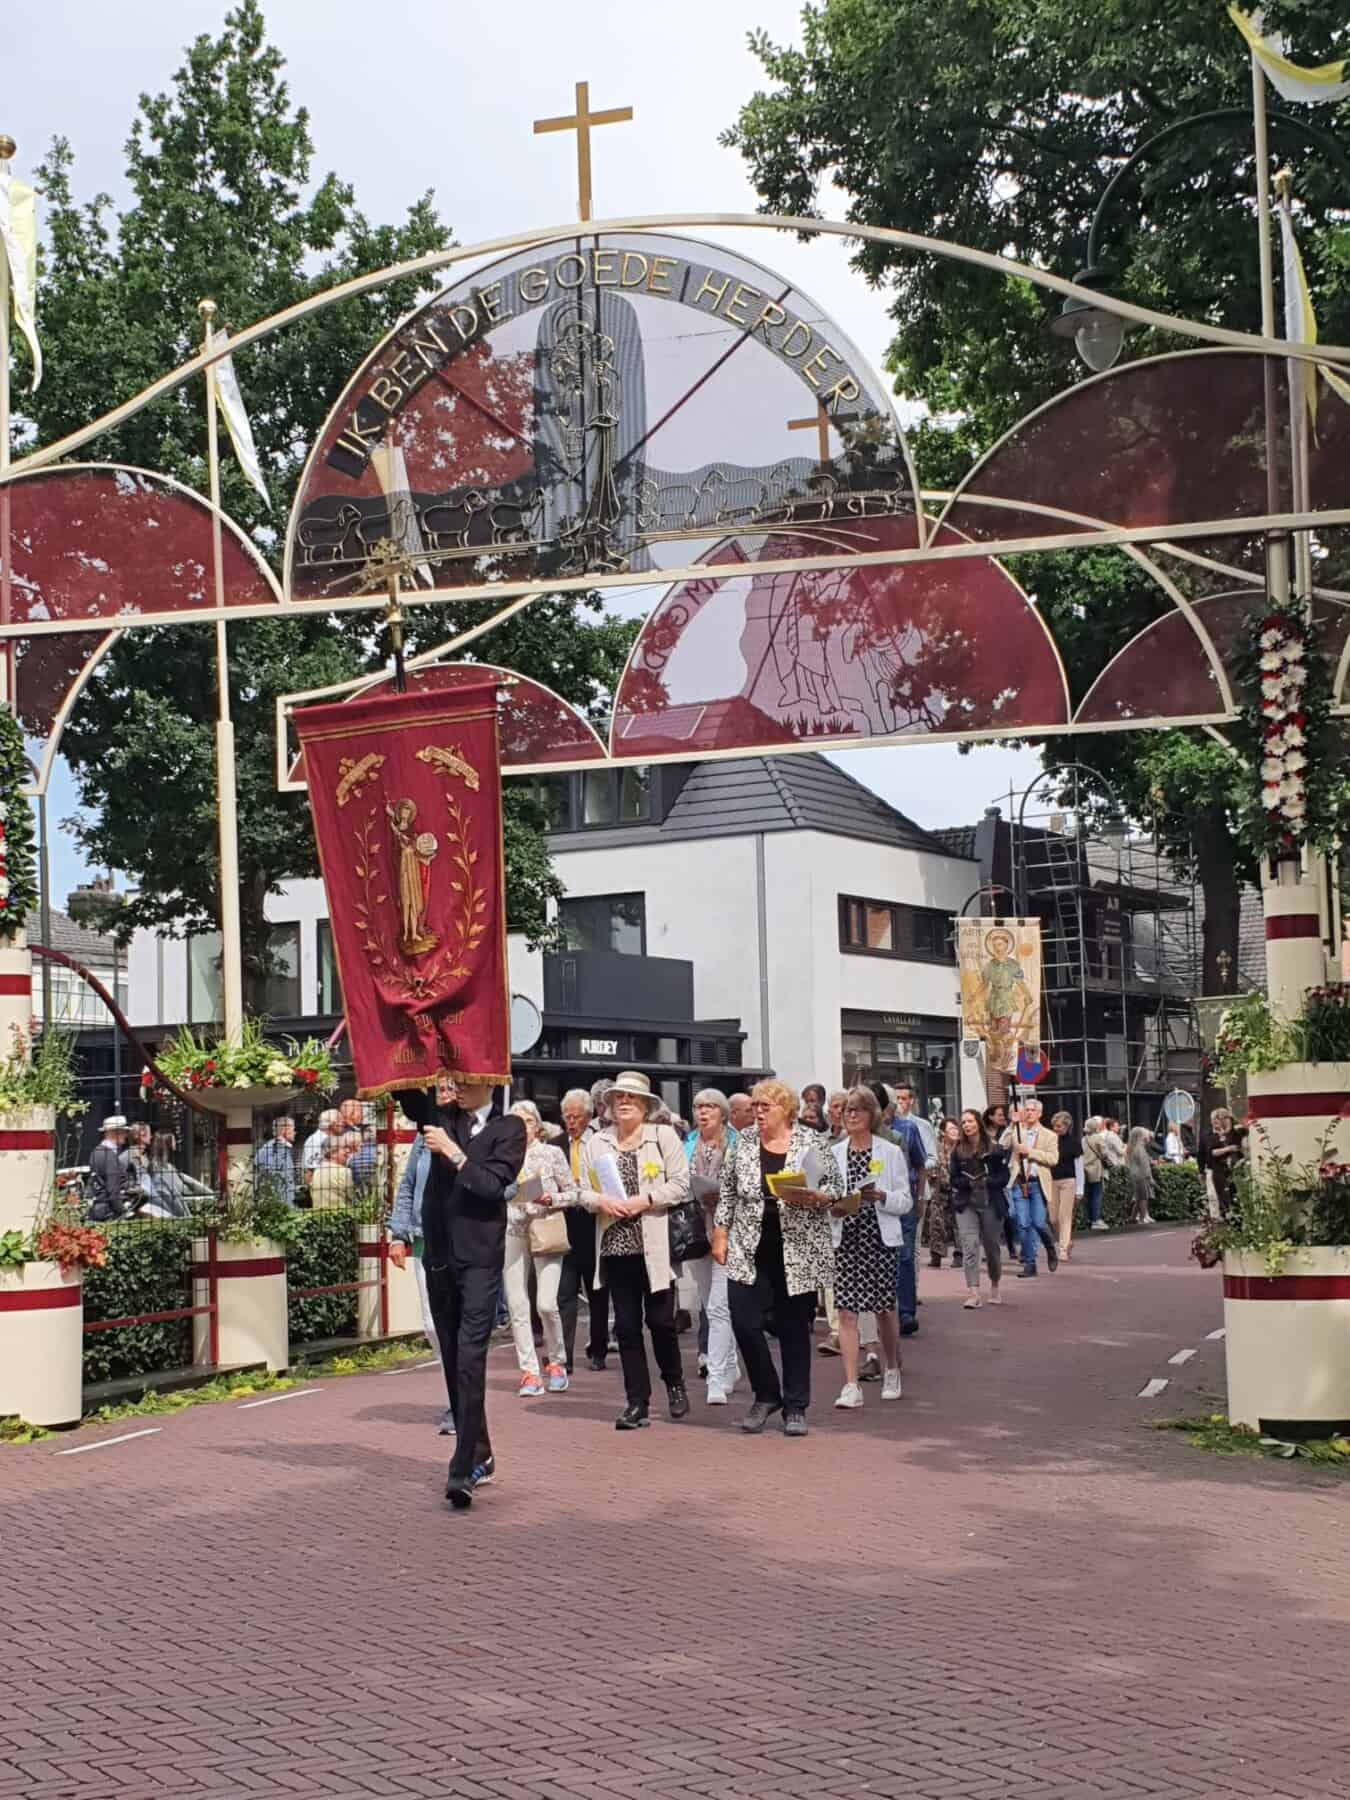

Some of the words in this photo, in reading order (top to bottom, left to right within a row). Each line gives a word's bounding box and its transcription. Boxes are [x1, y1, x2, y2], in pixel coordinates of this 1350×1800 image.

[336, 409, 383, 458] IK
[367, 325, 449, 413] BEN
[448, 281, 512, 341] DE
[518, 249, 679, 303] GOEDE
[694, 269, 861, 418] HERDER
